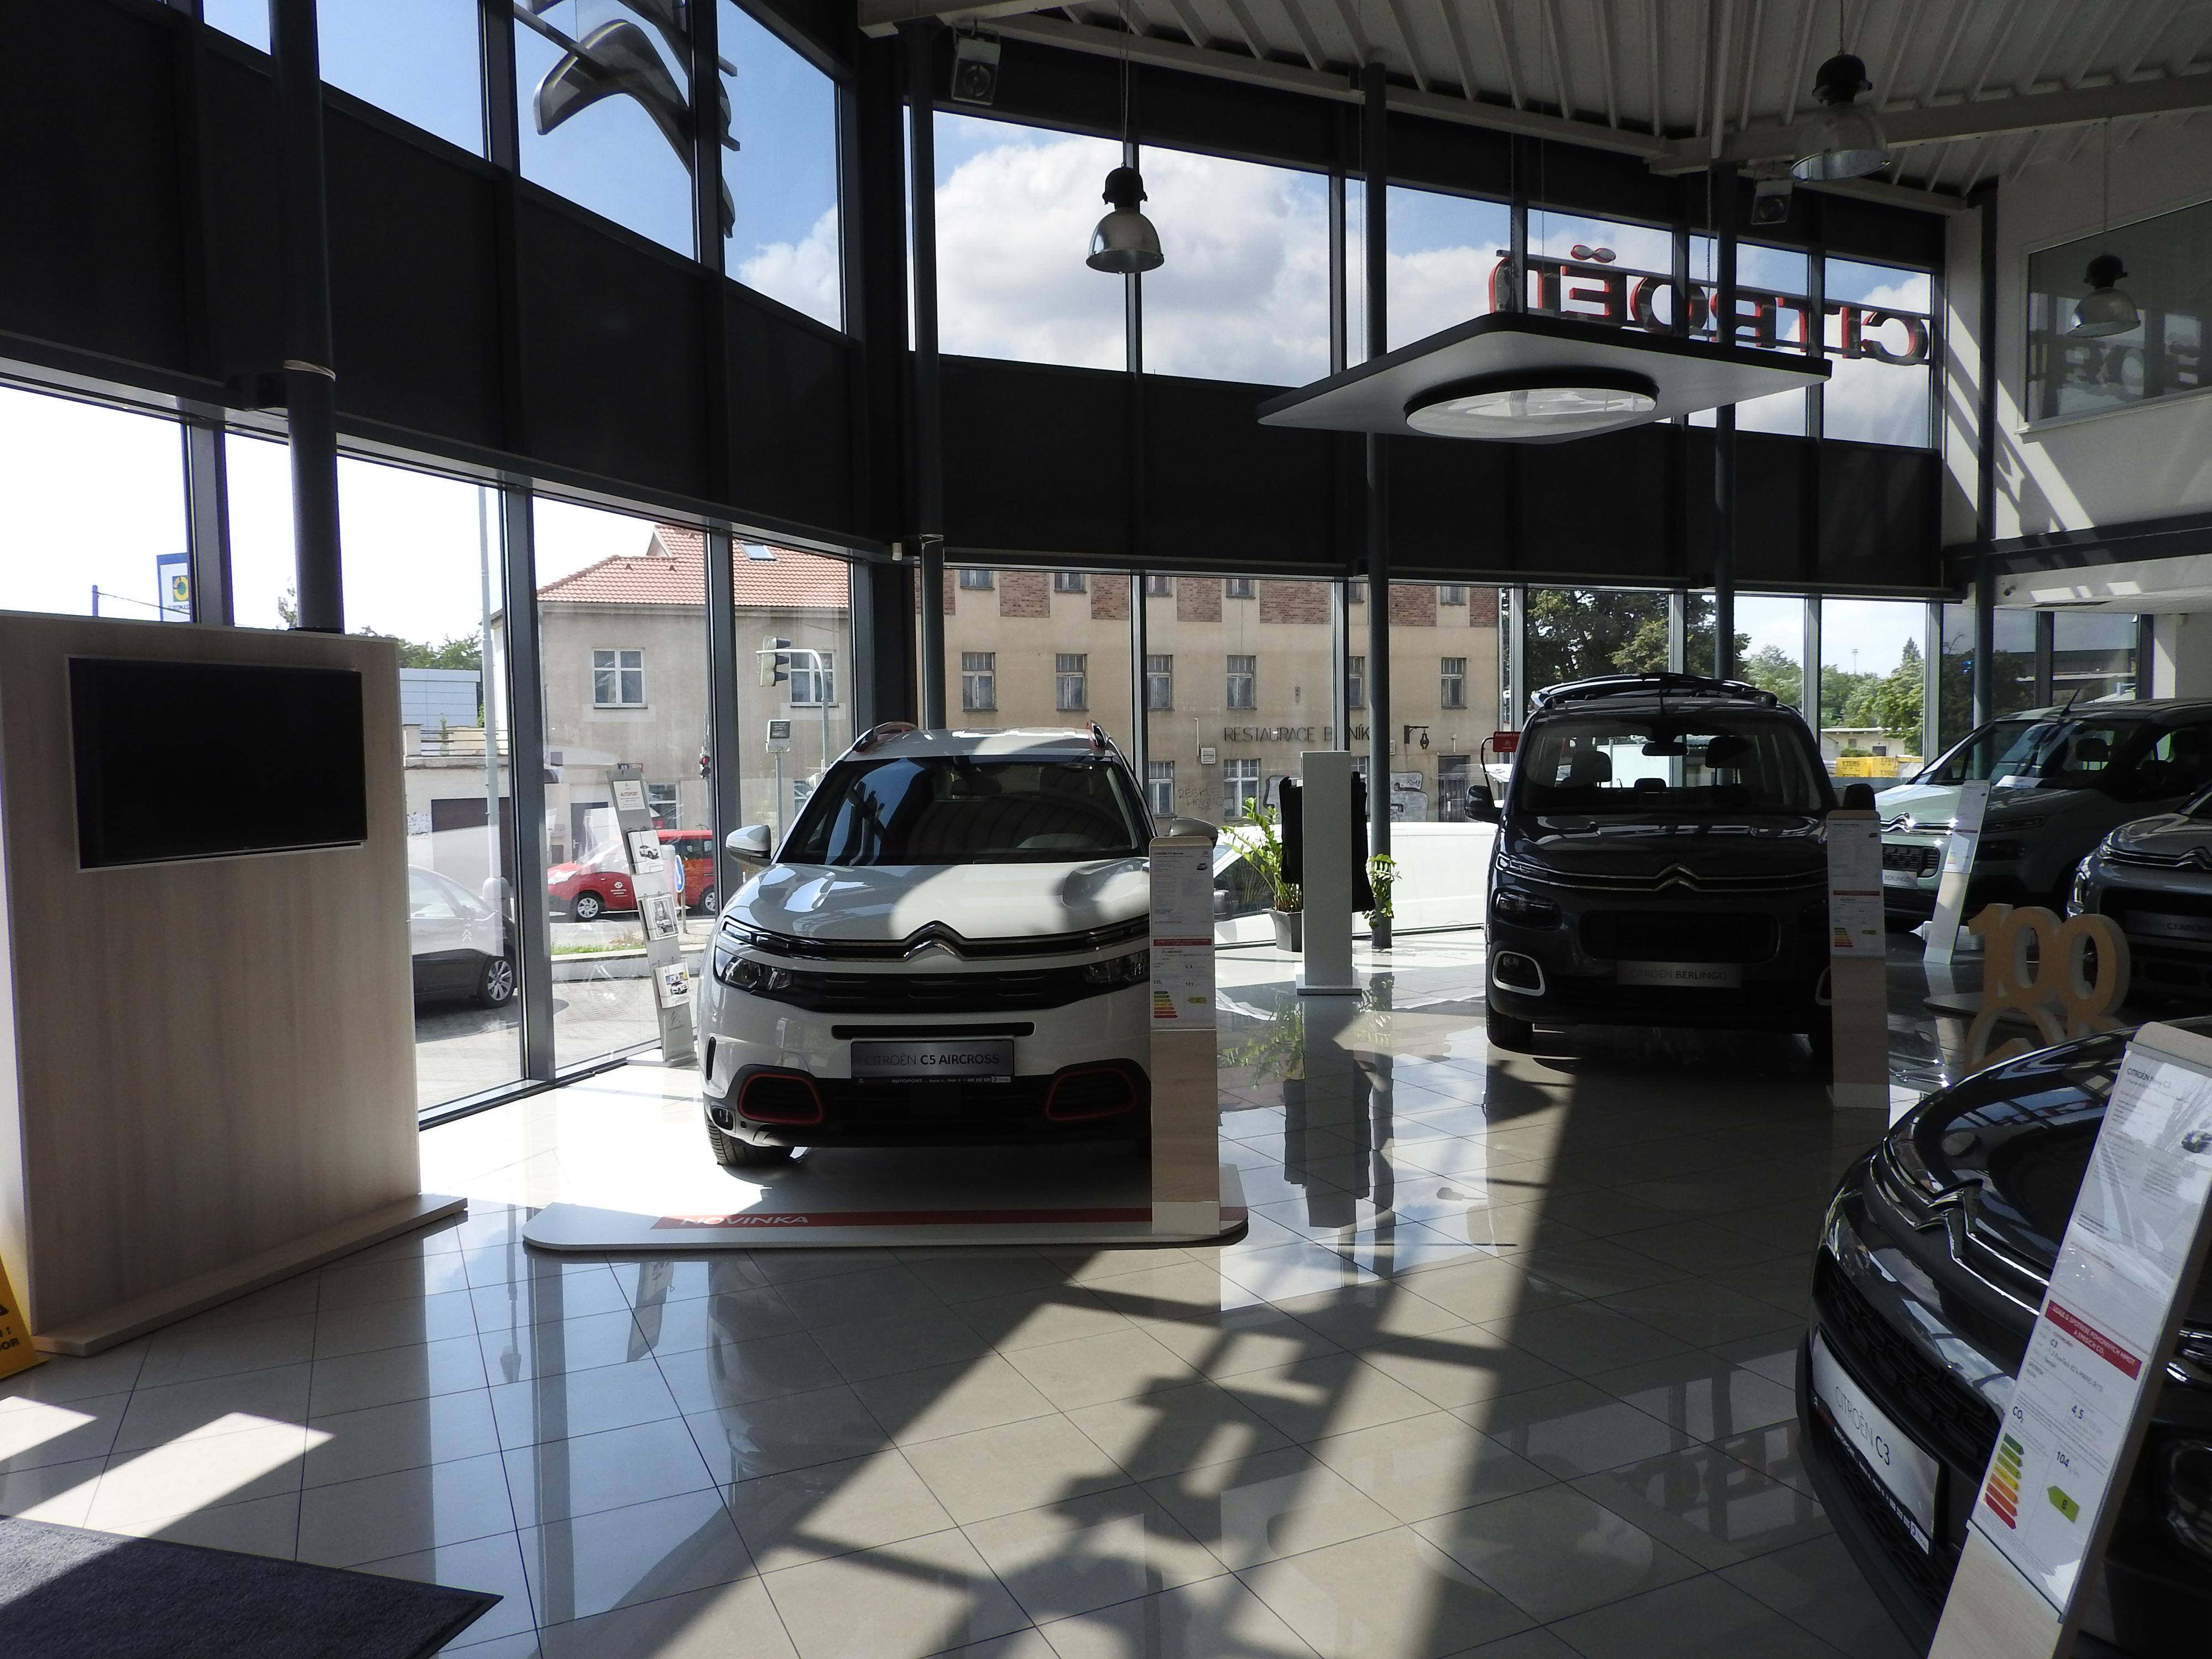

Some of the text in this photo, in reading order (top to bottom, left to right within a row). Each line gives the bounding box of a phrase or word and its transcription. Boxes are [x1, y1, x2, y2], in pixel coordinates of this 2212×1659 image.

[1224, 723, 1370, 742] RESTAURACE BNÍK
[1967, 902, 2126, 1016] 100
[1675, 971, 1726, 980] BERLINGO
[864, 1052, 1000, 1066] CITROËN C5 AIRCROSS
[679, 1217, 808, 1225] NOVINKA
[1835, 1386, 1874, 1447] CITROËN
[1875, 1435, 1891, 1466] C3
[2056, 1451, 2069, 1468] 104
[2061, 1499, 2068, 1510] B
